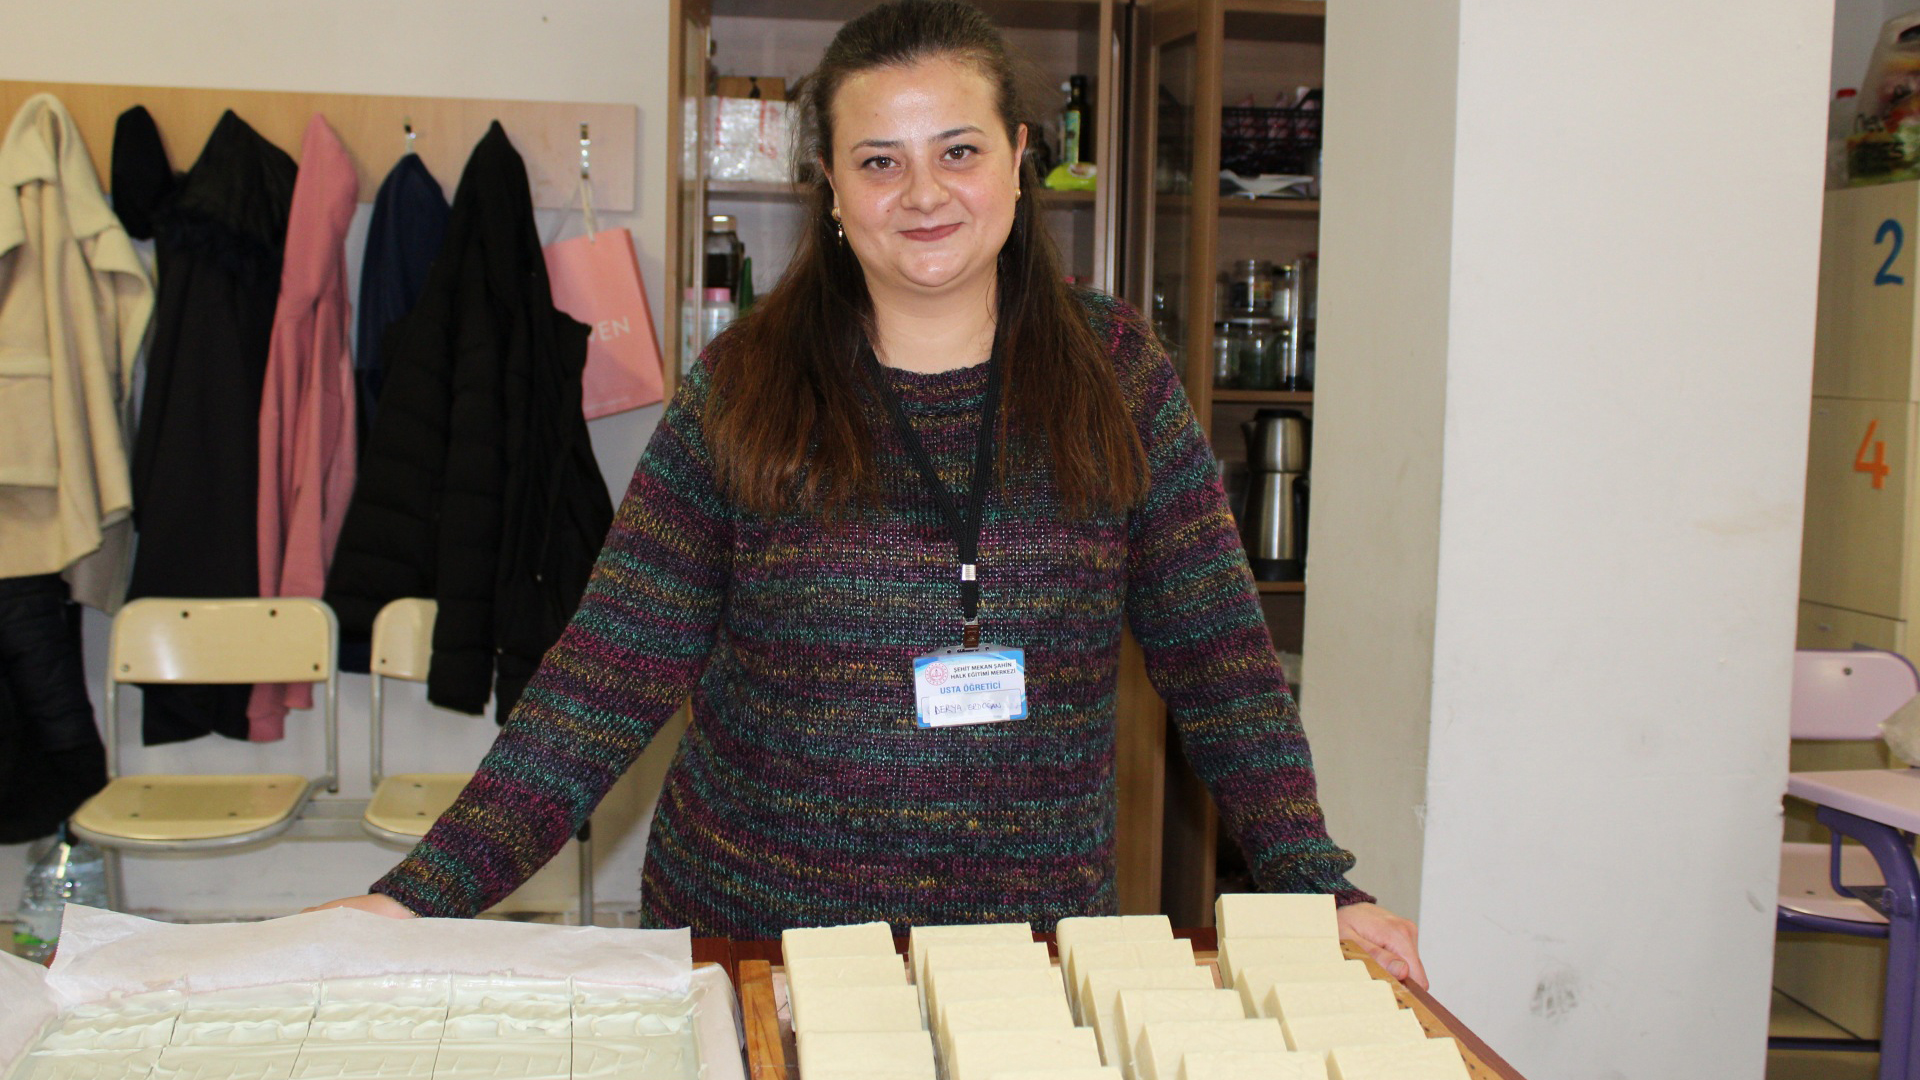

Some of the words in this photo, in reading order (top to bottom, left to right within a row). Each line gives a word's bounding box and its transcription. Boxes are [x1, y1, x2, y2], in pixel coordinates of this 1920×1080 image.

[1874, 219, 1904, 286] 2
[1853, 418, 1891, 490] 4
[953, 665, 971, 673] ŞEHİT
[971, 663, 993, 671] MEKAN
[993, 661, 1012, 670] ŞAHİN
[967, 670, 990, 678] EĞİTİMİ
[990, 667, 1016, 676] MERKEZİ
[940, 684, 961, 695] USTA
[963, 680, 1001, 692] ÖĞRETİCİ
